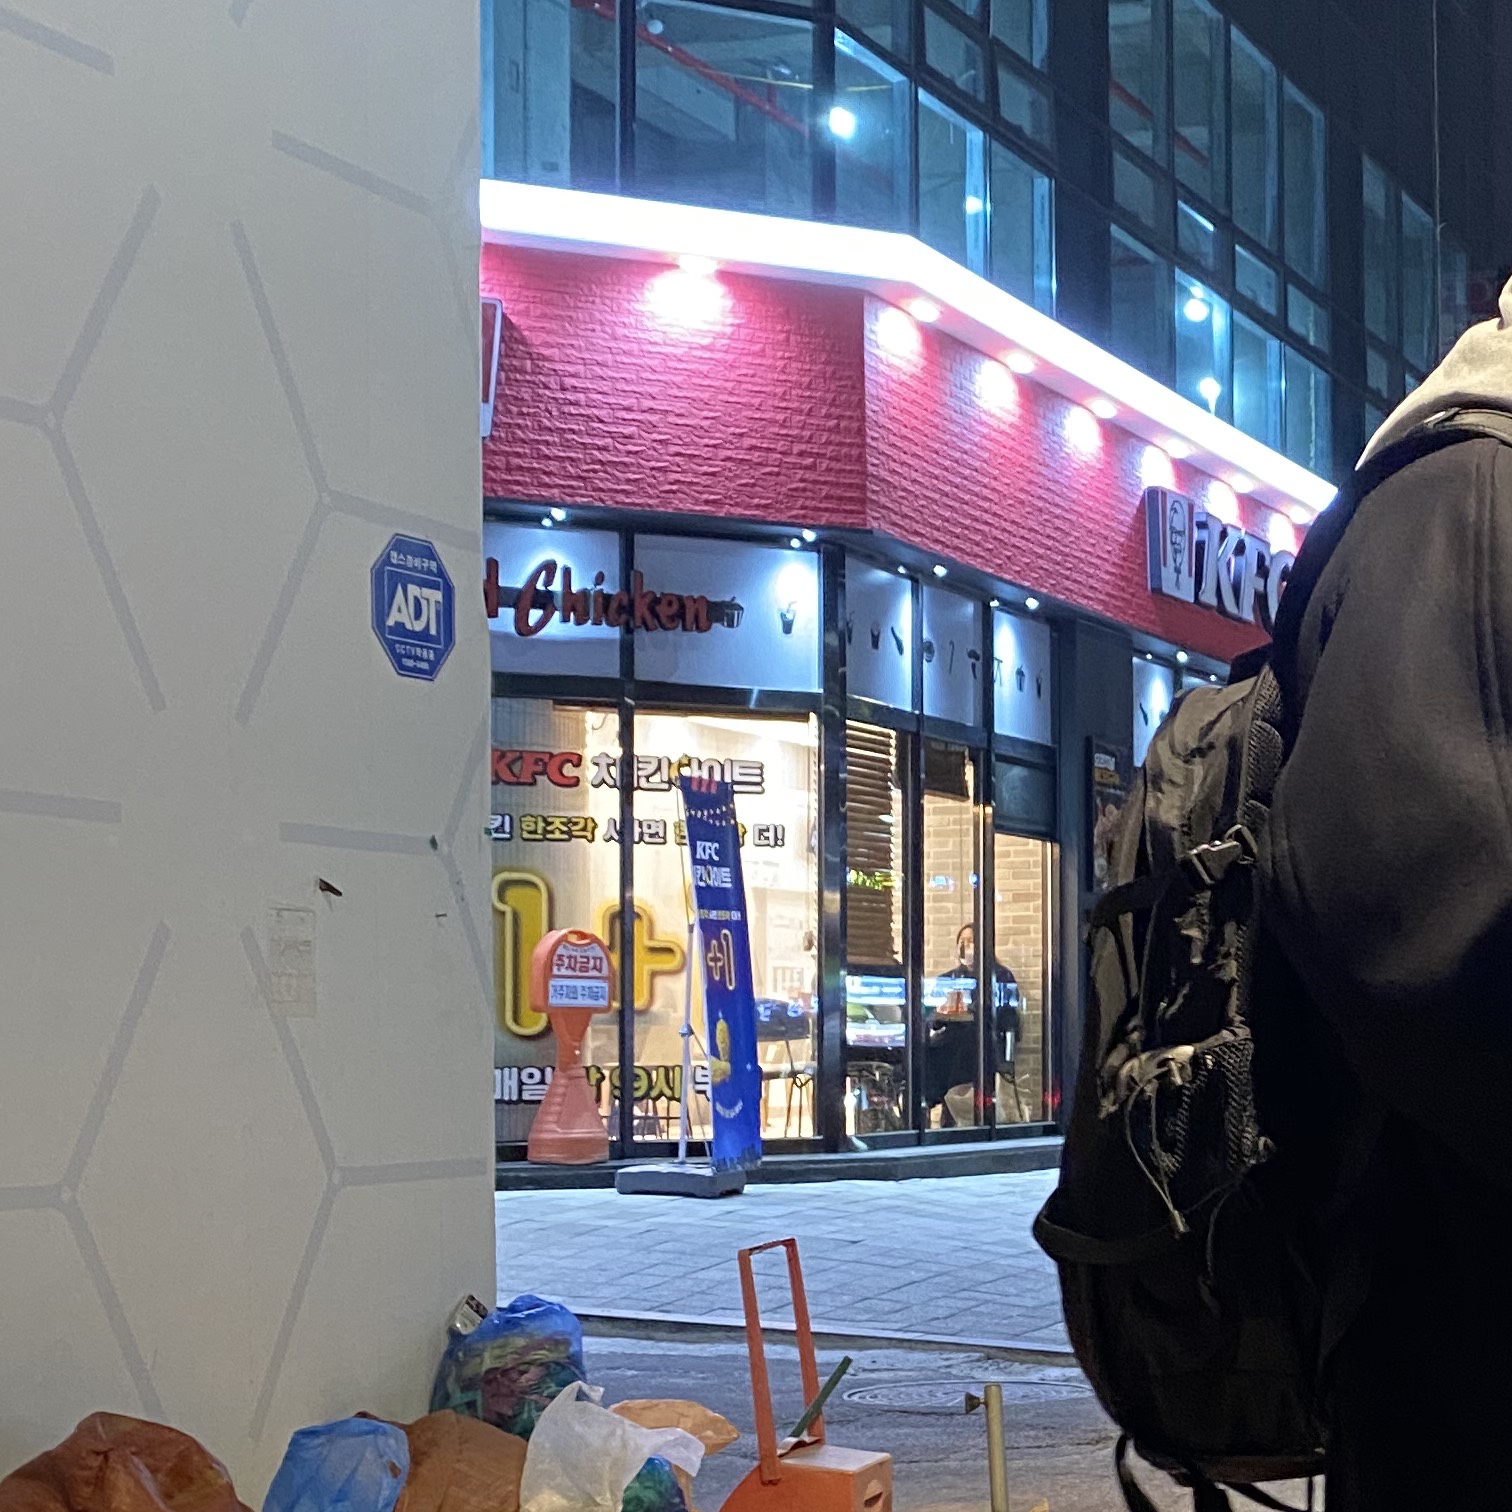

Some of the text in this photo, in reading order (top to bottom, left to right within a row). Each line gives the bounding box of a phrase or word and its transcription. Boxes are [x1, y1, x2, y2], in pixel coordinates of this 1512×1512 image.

[386, 582, 443, 636] ADT
[514, 558, 713, 638] Chicken
[491, 748, 583, 788] KFC
[519, 814, 599, 844] 한조각
[752, 823, 786, 848] 더!
[696, 841, 720, 861] KFC
[554, 953, 604, 974] 주차금지
